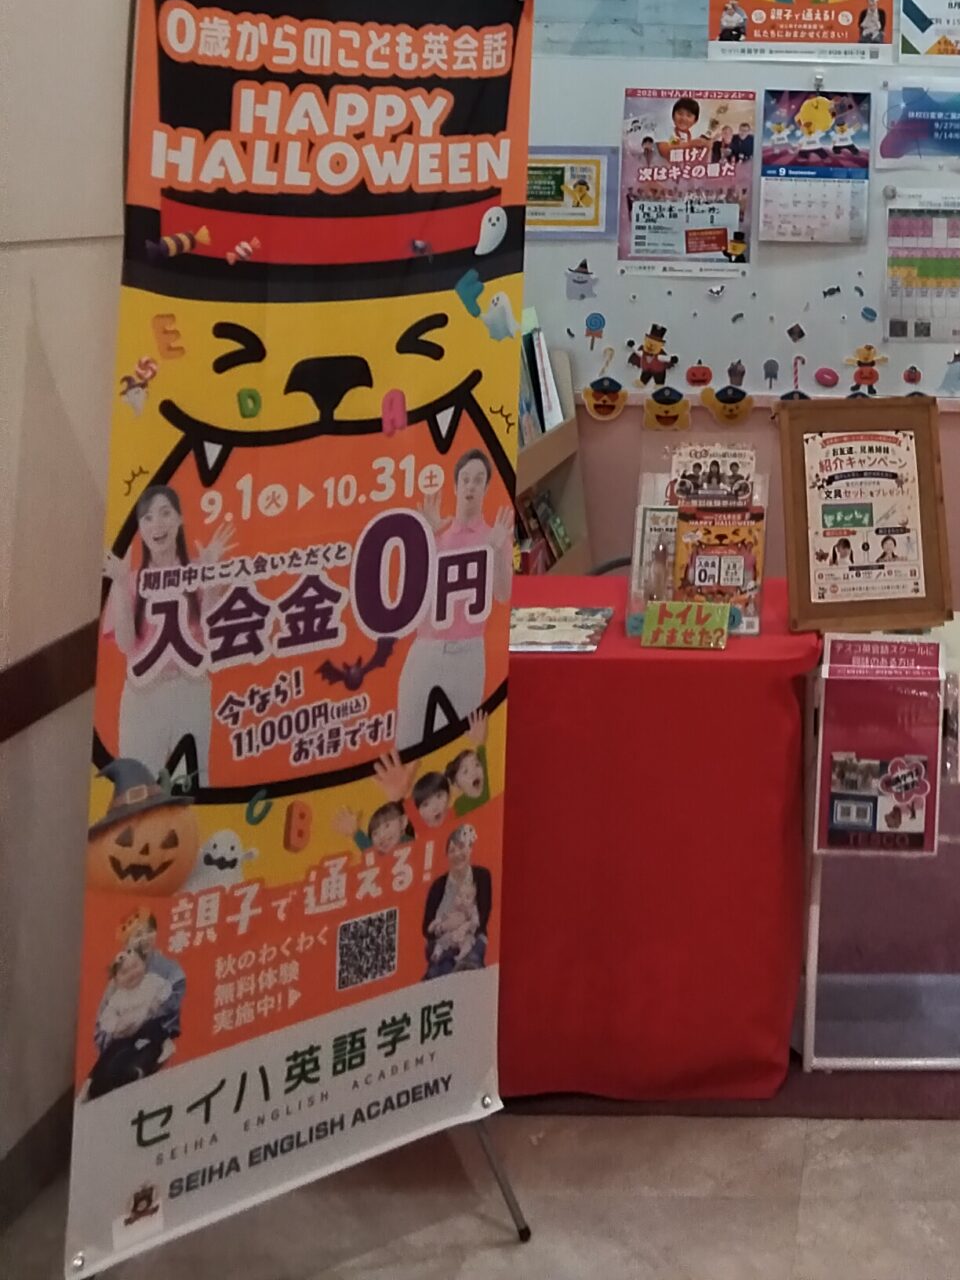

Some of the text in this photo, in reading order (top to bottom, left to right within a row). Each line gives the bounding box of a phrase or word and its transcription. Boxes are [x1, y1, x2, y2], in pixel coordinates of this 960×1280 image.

[166, 7, 509, 74] 0歳からのこども英会話
[240, 88, 449, 138] HAPPY
[150, 130, 512, 188] HALLOWEEN
[819, 456, 908, 473] 紹介キャンペーン
[142, 543, 349, 592] 期間中にご入会いただくと
[657, 603, 712, 625] トイレ
[218, 670, 303, 727] 今なら!
[292, 713, 394, 764] お得です!
[168, 840, 436, 955] 親子で通える!
[215, 927, 331, 976] 秋のわくわく
[214, 960, 301, 1007] 無料体験
[130, 999, 456, 1149] セイハ英語学院
[154, 1051, 439, 1166] SEIHA ENGLISH ACADEMY
[168, 1074, 454, 1200] SEIHA ENGLISH ACADEMY
